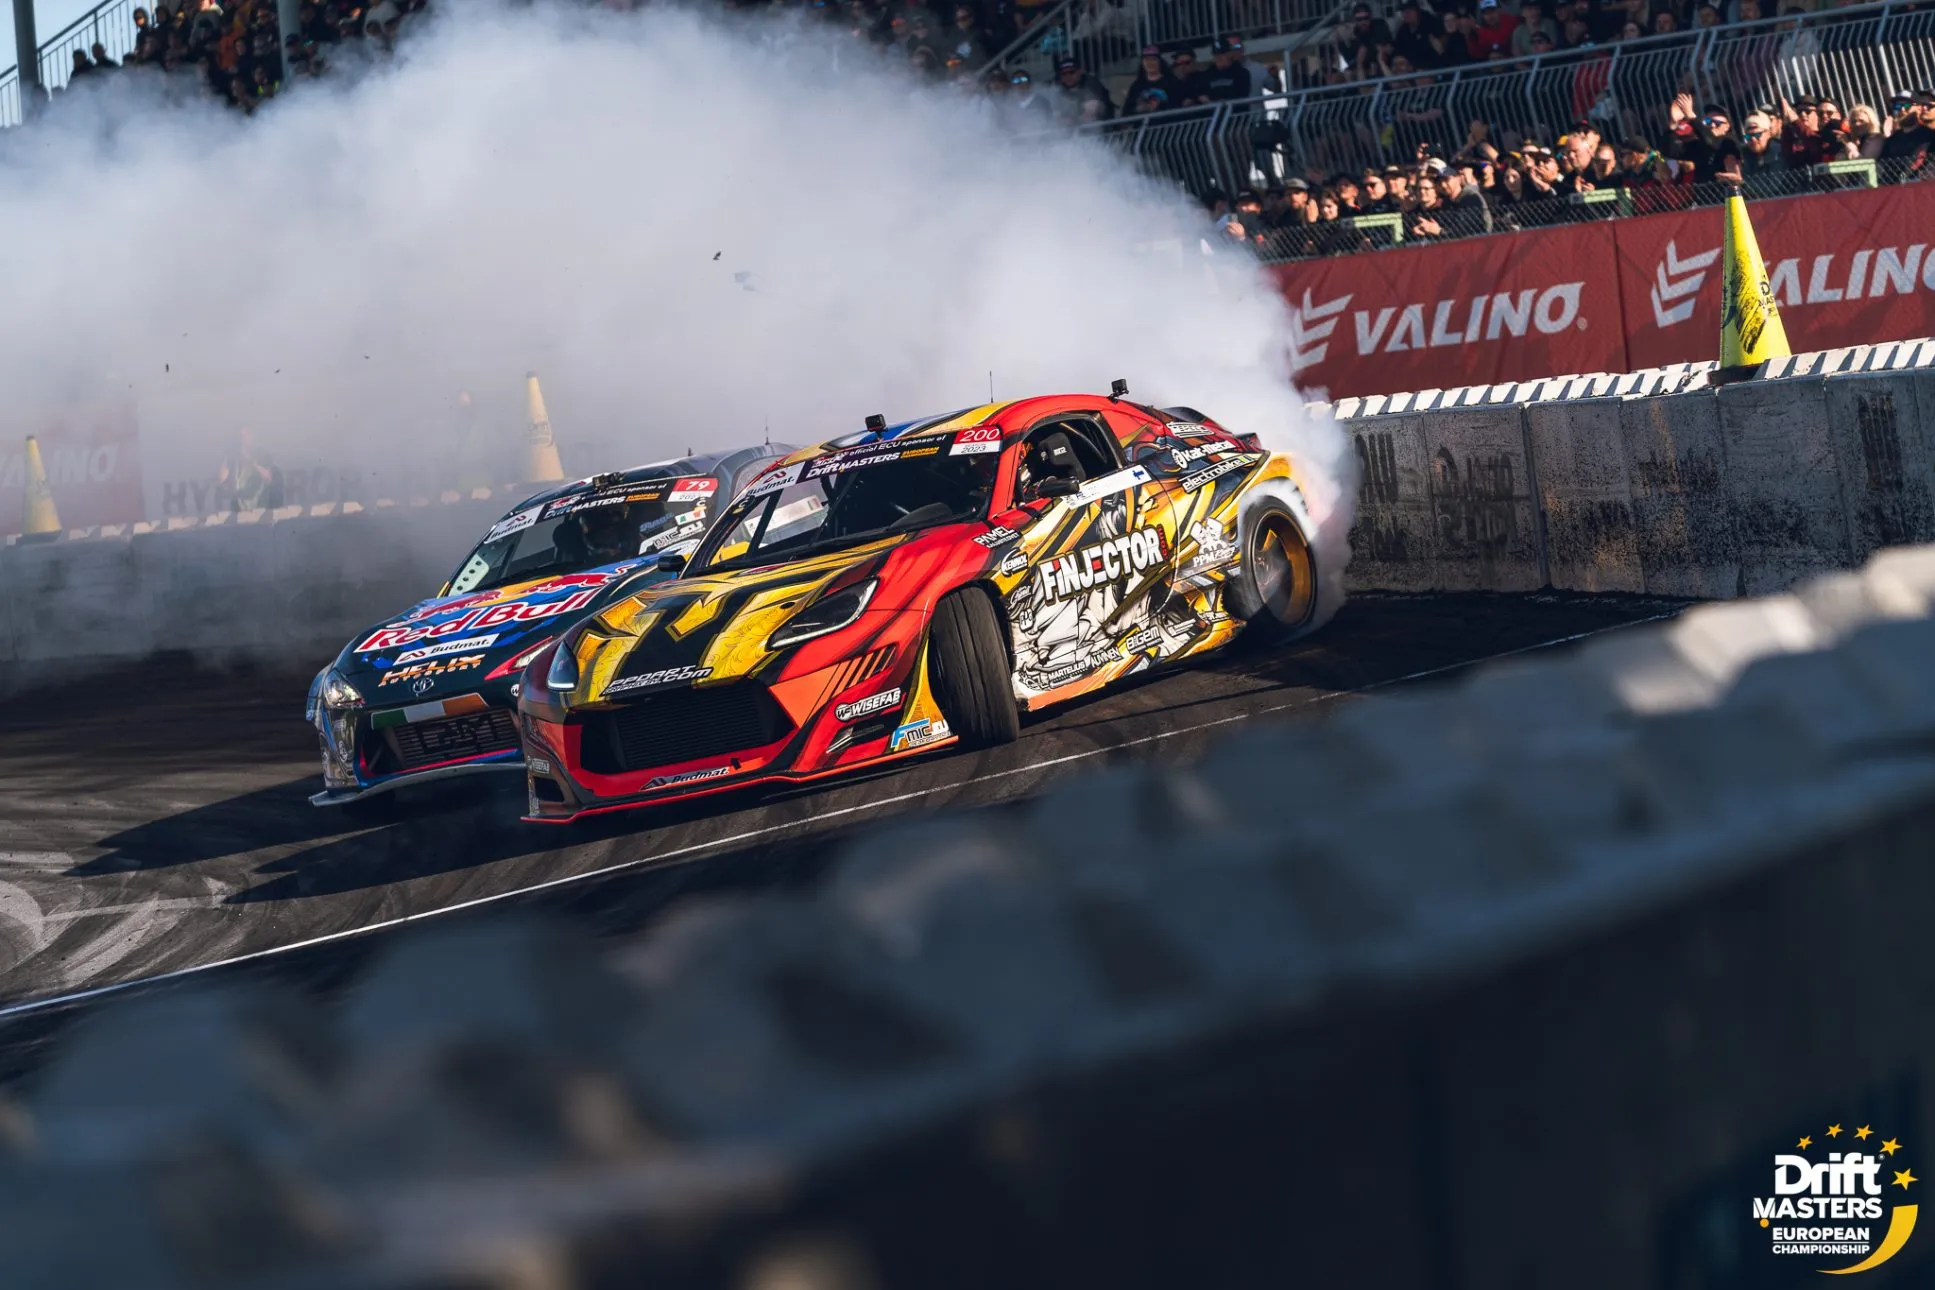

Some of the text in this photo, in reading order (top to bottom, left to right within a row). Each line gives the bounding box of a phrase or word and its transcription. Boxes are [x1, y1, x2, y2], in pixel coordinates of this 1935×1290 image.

[1764, 243, 1935, 307] ALIN
[1353, 281, 1586, 356] VALINO
[878, 441, 901, 450] ECU
[901, 437, 935, 447] sponsor
[960, 428, 1000, 442] 200
[961, 445, 986, 454] 2023
[806, 463, 840, 478] Drift
[839, 452, 901, 470] MASTERS
[685, 480, 710, 491] 79
[571, 496, 626, 510] MASTERS
[353, 588, 603, 653] Red Bull
[382, 654, 486, 680] HELIX
[852, 690, 900, 716] WISEFAB
